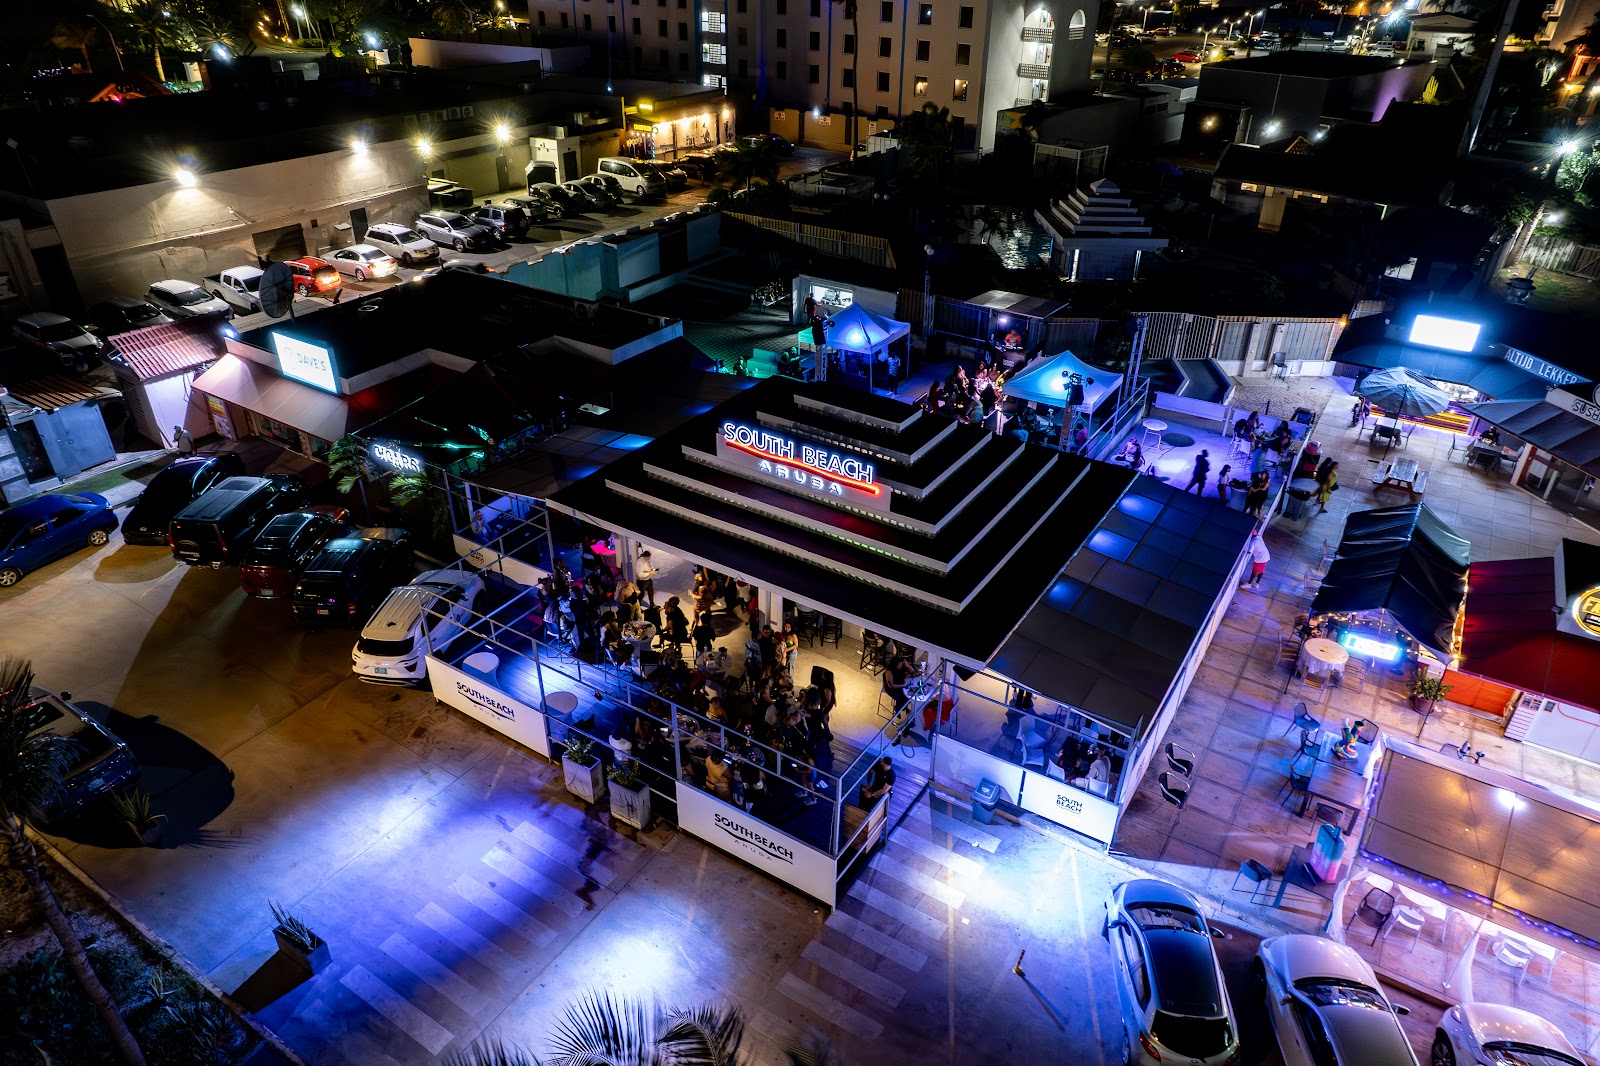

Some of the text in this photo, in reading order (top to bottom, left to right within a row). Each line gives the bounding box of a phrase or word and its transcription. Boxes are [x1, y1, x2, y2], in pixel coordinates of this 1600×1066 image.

[297, 352, 327, 372] DAVE'S
[1504, 348, 1534, 370] ALTIJD
[1572, 399, 1600, 423] SUSH
[723, 422, 874, 485] SOUTH BEACH
[758, 459, 843, 496] ARUBA
[1056, 794, 1083, 808] SOUTH
[1056, 799, 1082, 814] BEACH
